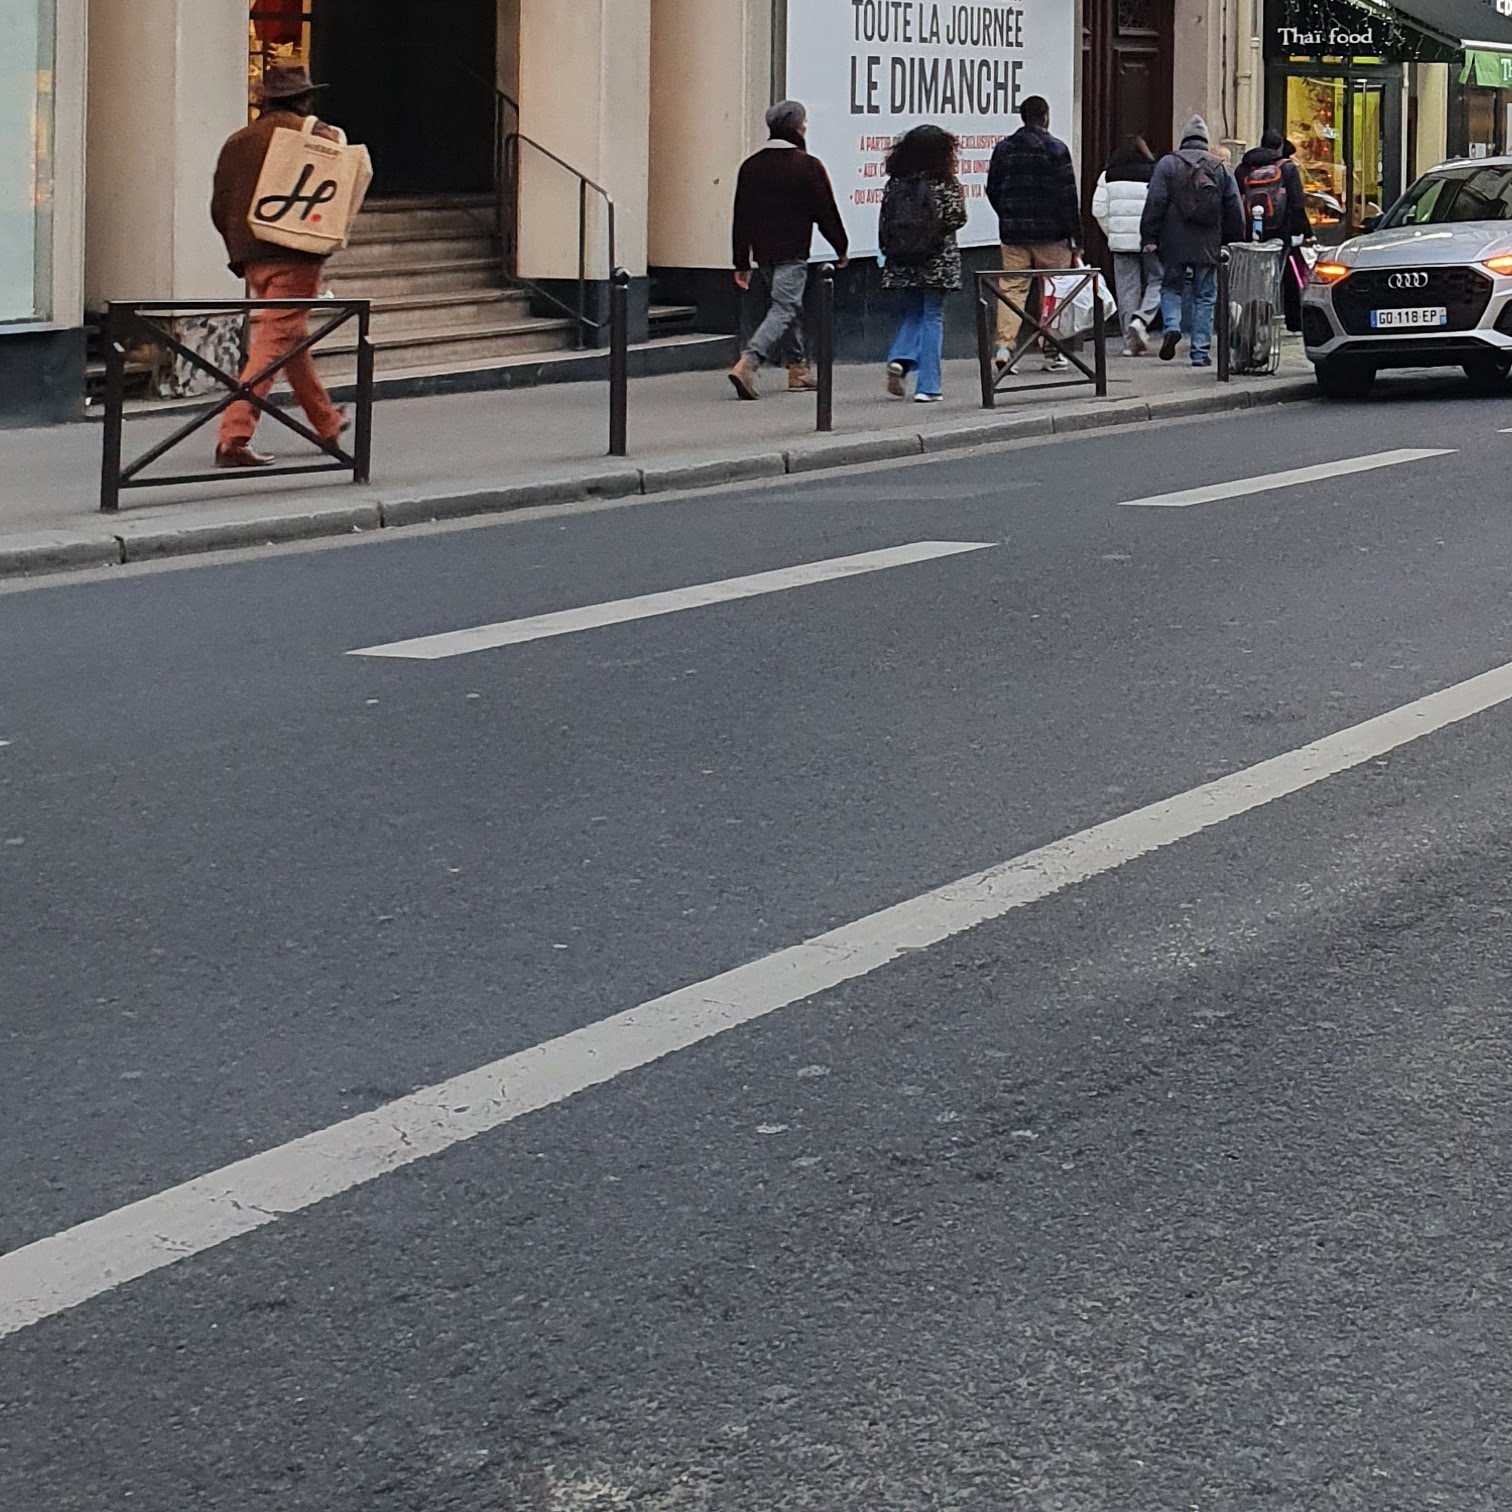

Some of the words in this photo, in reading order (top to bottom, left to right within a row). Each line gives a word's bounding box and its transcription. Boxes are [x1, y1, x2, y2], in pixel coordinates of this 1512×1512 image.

[919, 3, 940, 44] LA
[946, 5, 1024, 48] JOURNÉE
[1277, 28, 1322, 47] Thaï
[1328, 28, 1374, 45] food
[850, 55, 881, 115] LE
[890, 56, 1023, 115] DIMANCHE
